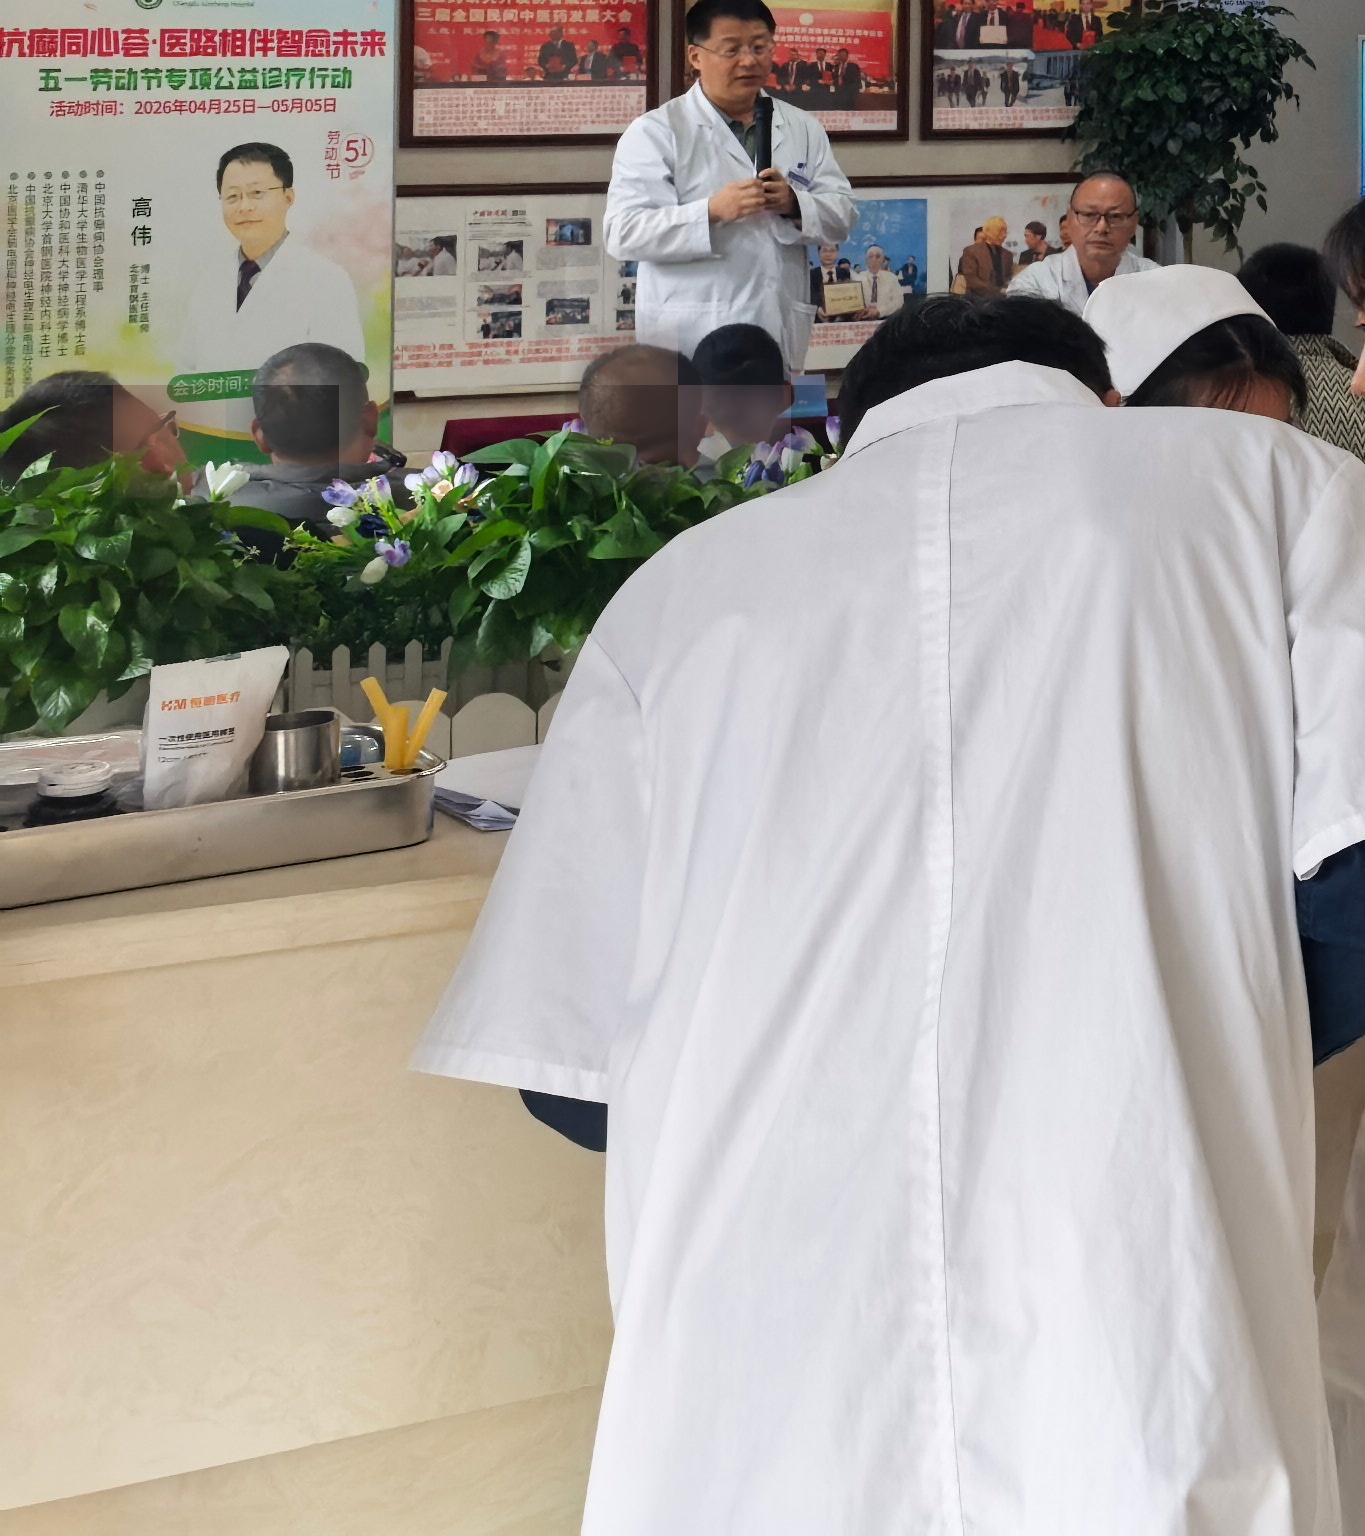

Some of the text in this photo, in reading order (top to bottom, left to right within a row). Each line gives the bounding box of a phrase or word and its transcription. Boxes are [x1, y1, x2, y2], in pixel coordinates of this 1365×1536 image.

[0, 27, 386, 58] 抗癫同心荟·医路相伴智愈未来
[38, 67, 352, 92] 五一劳动节专项公益诊疗行动
[324, 130, 341, 180] 劳动节
[131, 197, 152, 247] 高伟
[172, 375, 255, 397] 会诊时间：
